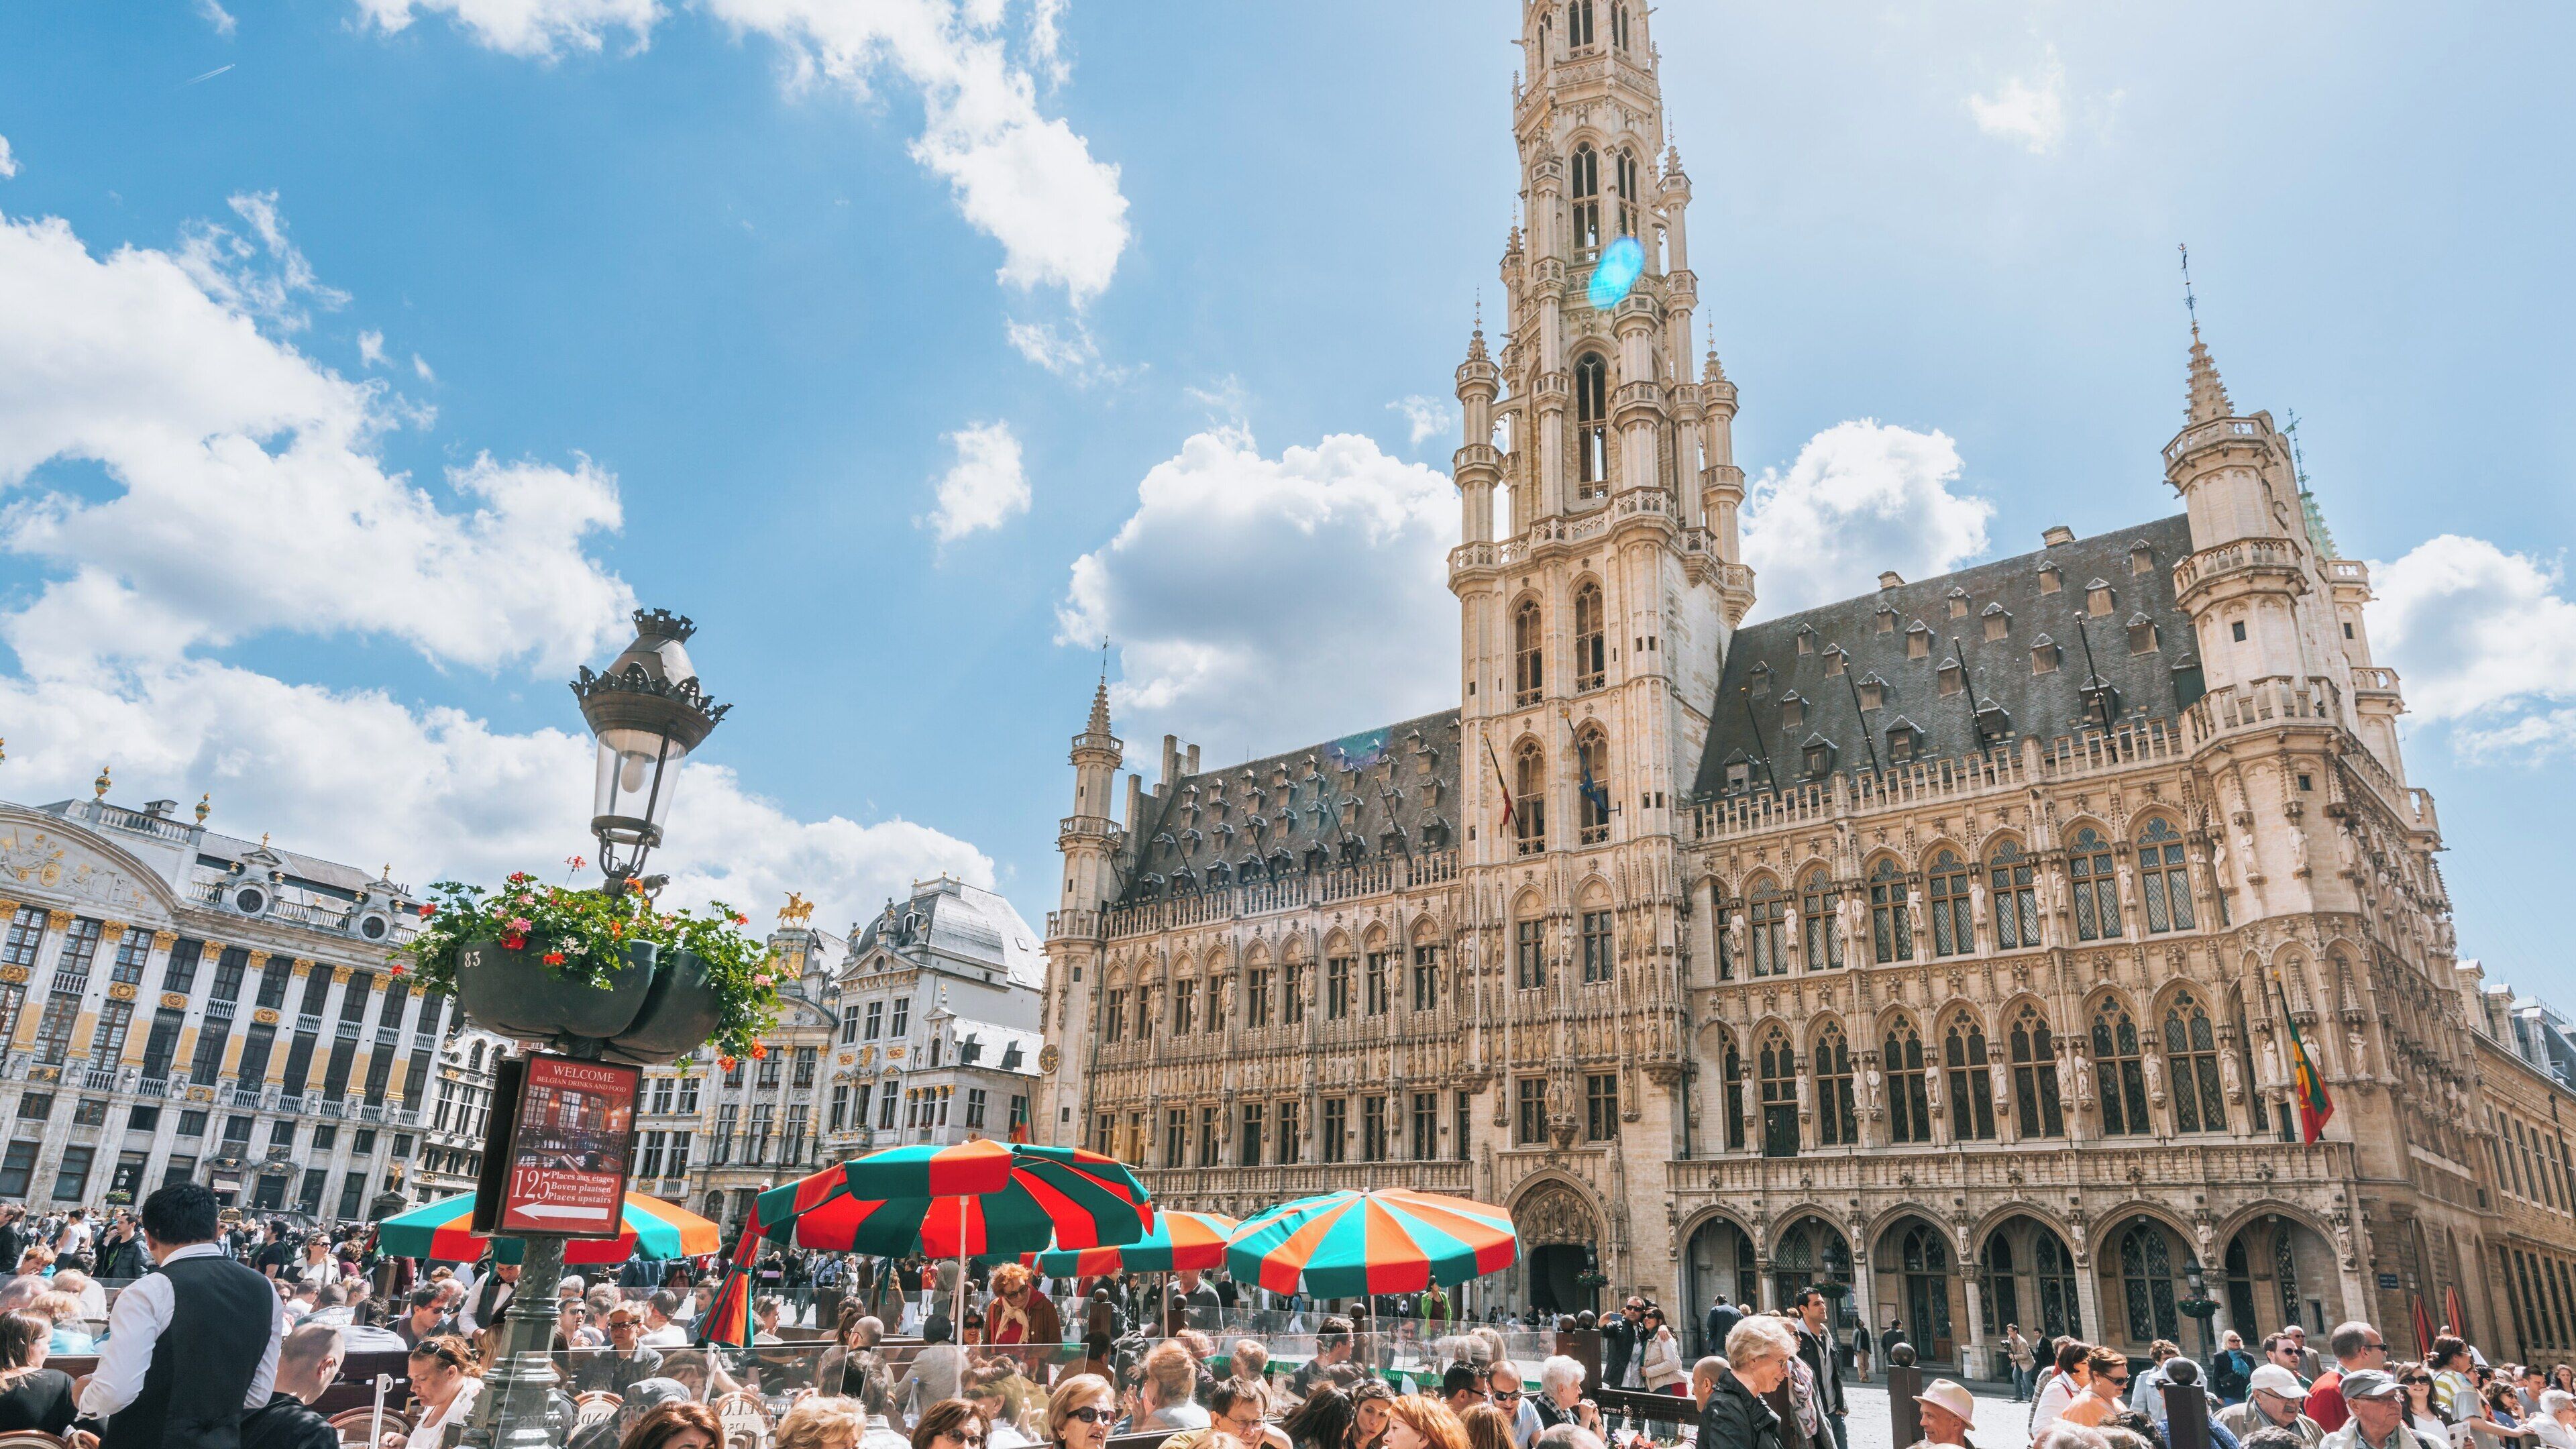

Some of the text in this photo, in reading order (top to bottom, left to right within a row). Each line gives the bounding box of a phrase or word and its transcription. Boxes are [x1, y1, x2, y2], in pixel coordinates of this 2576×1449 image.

[464, 950, 482, 968] 83
[553, 1065, 615, 1083] WELCOME
[536, 1075, 627, 1093] BELGIAN DRINKS AND FOOD
[512, 1169, 553, 1200] 125
[551, 1171, 614, 1185] Places aux étages
[551, 1182, 611, 1195] Boven plaatsen
[547, 1191, 612, 1205] Places upstairs
